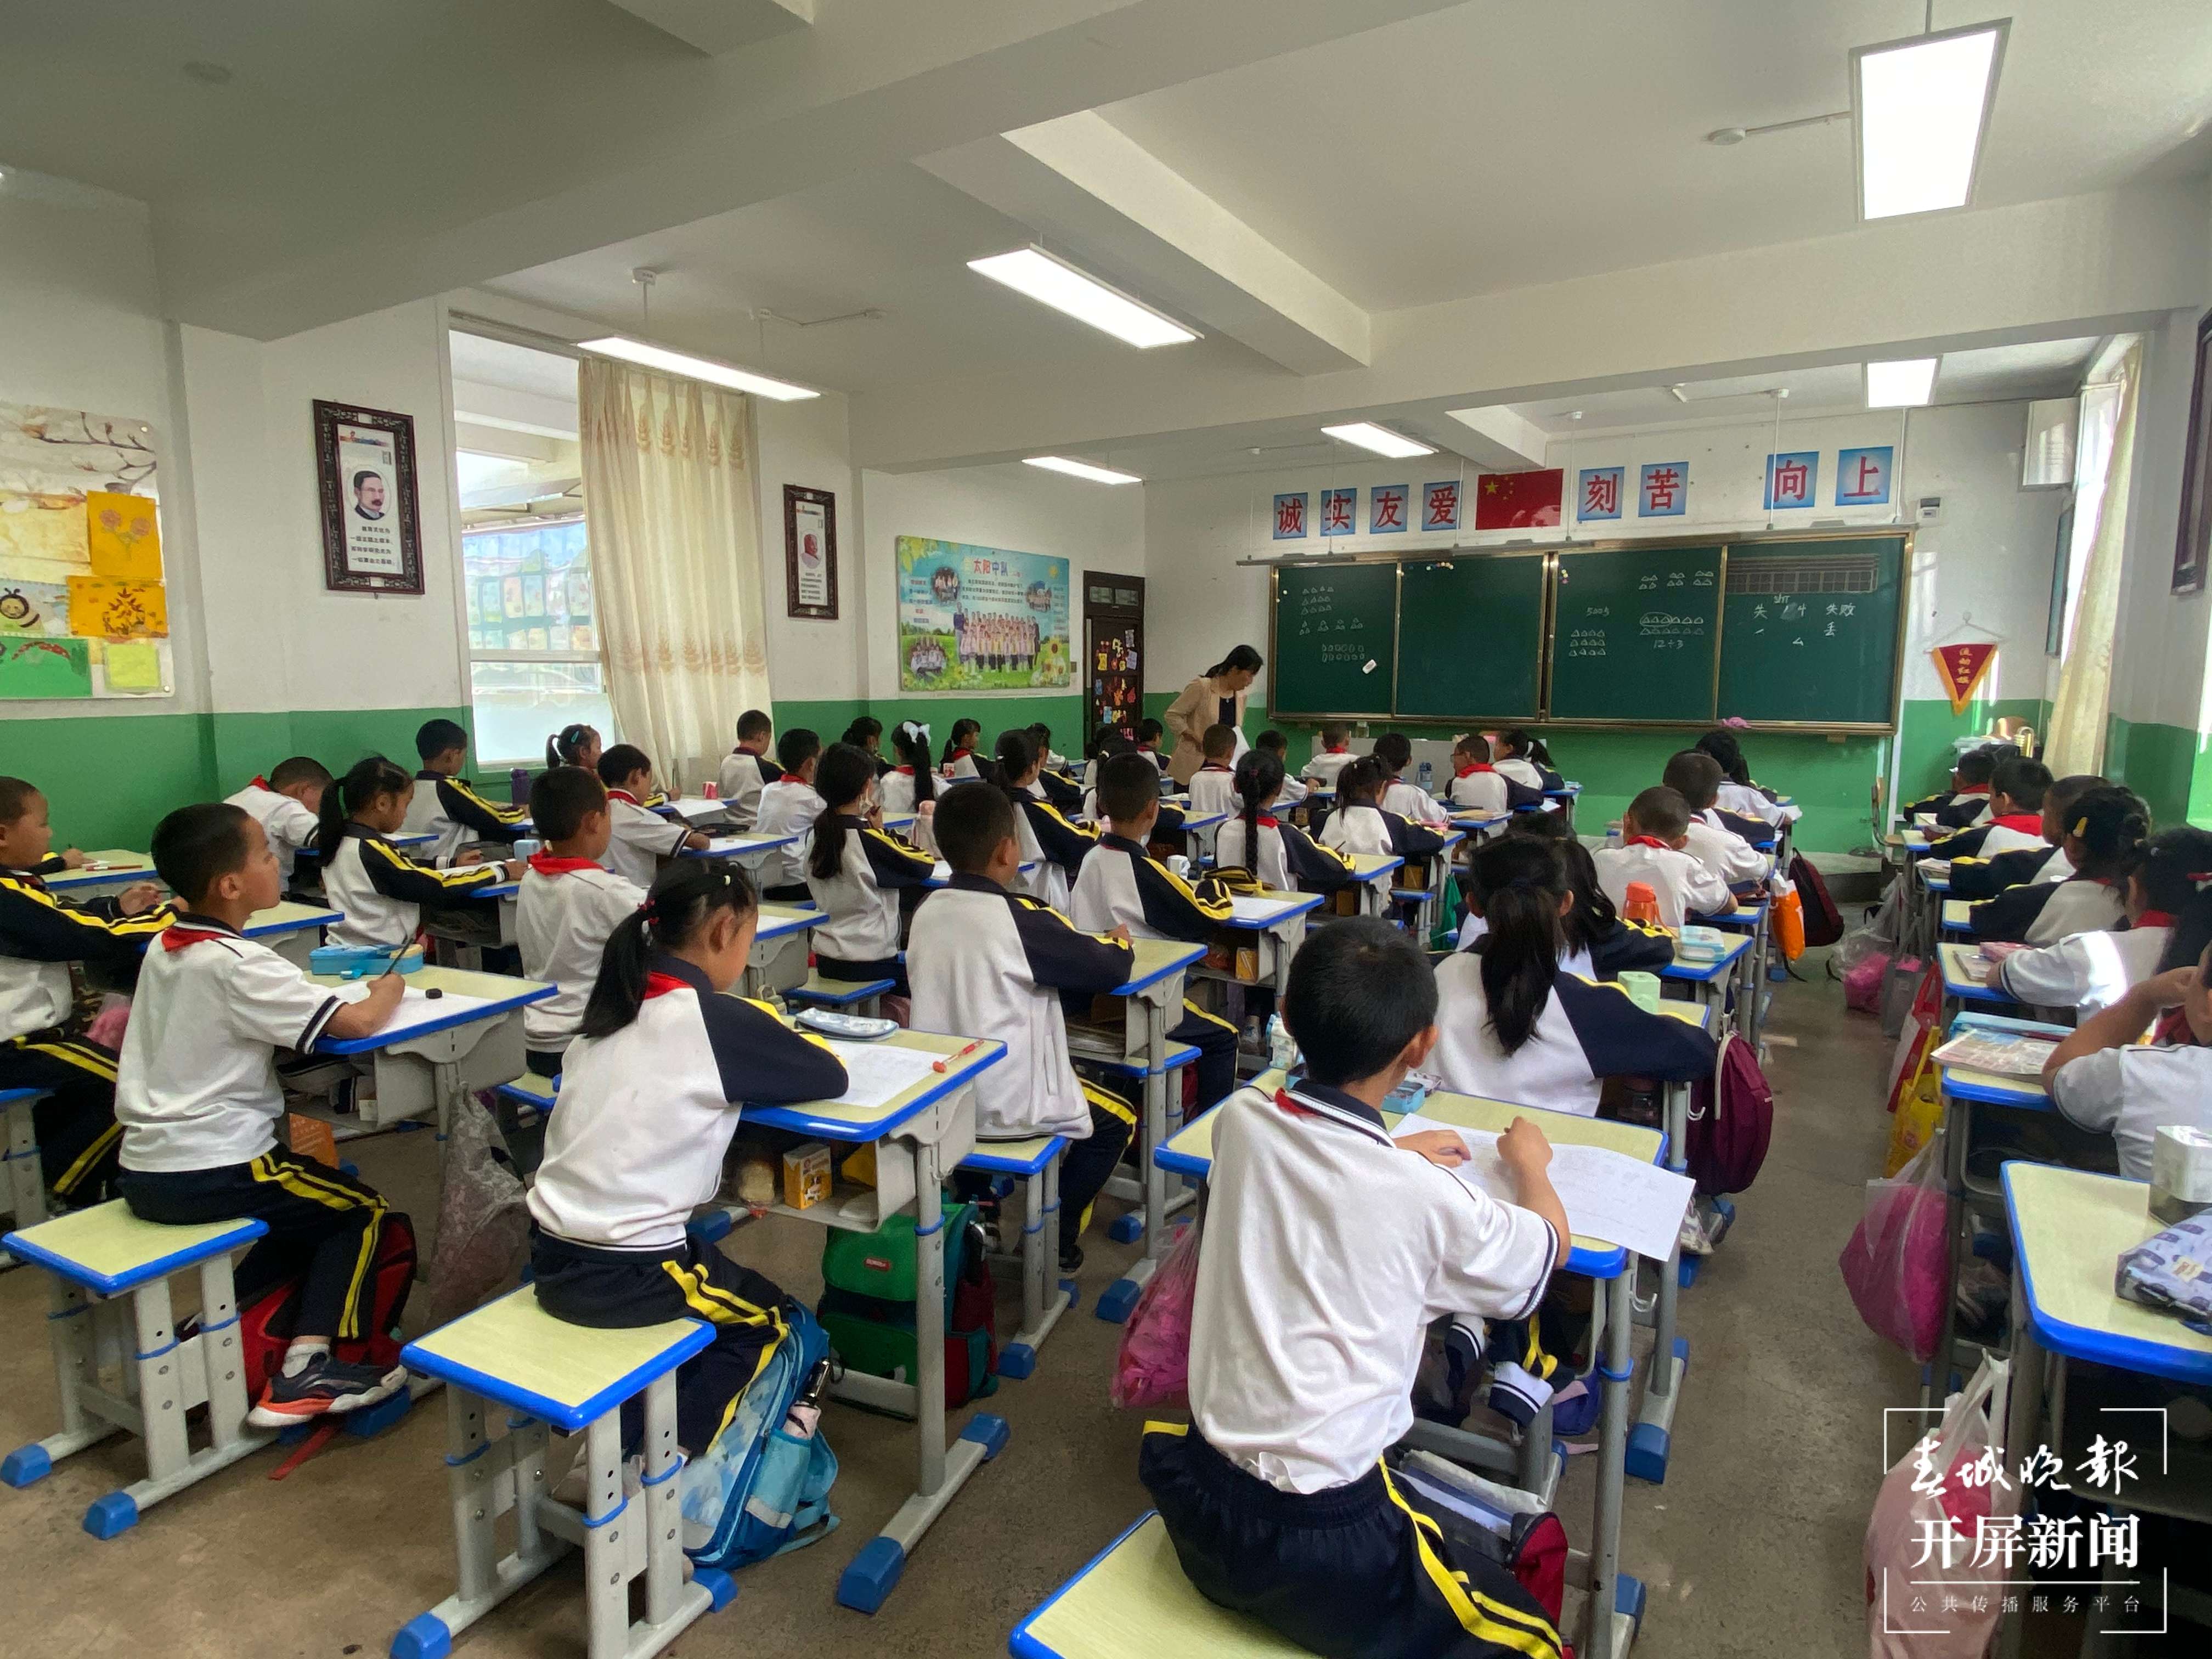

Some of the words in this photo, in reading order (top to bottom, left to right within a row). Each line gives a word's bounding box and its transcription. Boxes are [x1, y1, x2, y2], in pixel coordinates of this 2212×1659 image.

[1278, 486, 1458, 533] 诚实友爱
[1587, 468, 1680, 514] 刻苦
[1773, 456, 1881, 503] 向上
